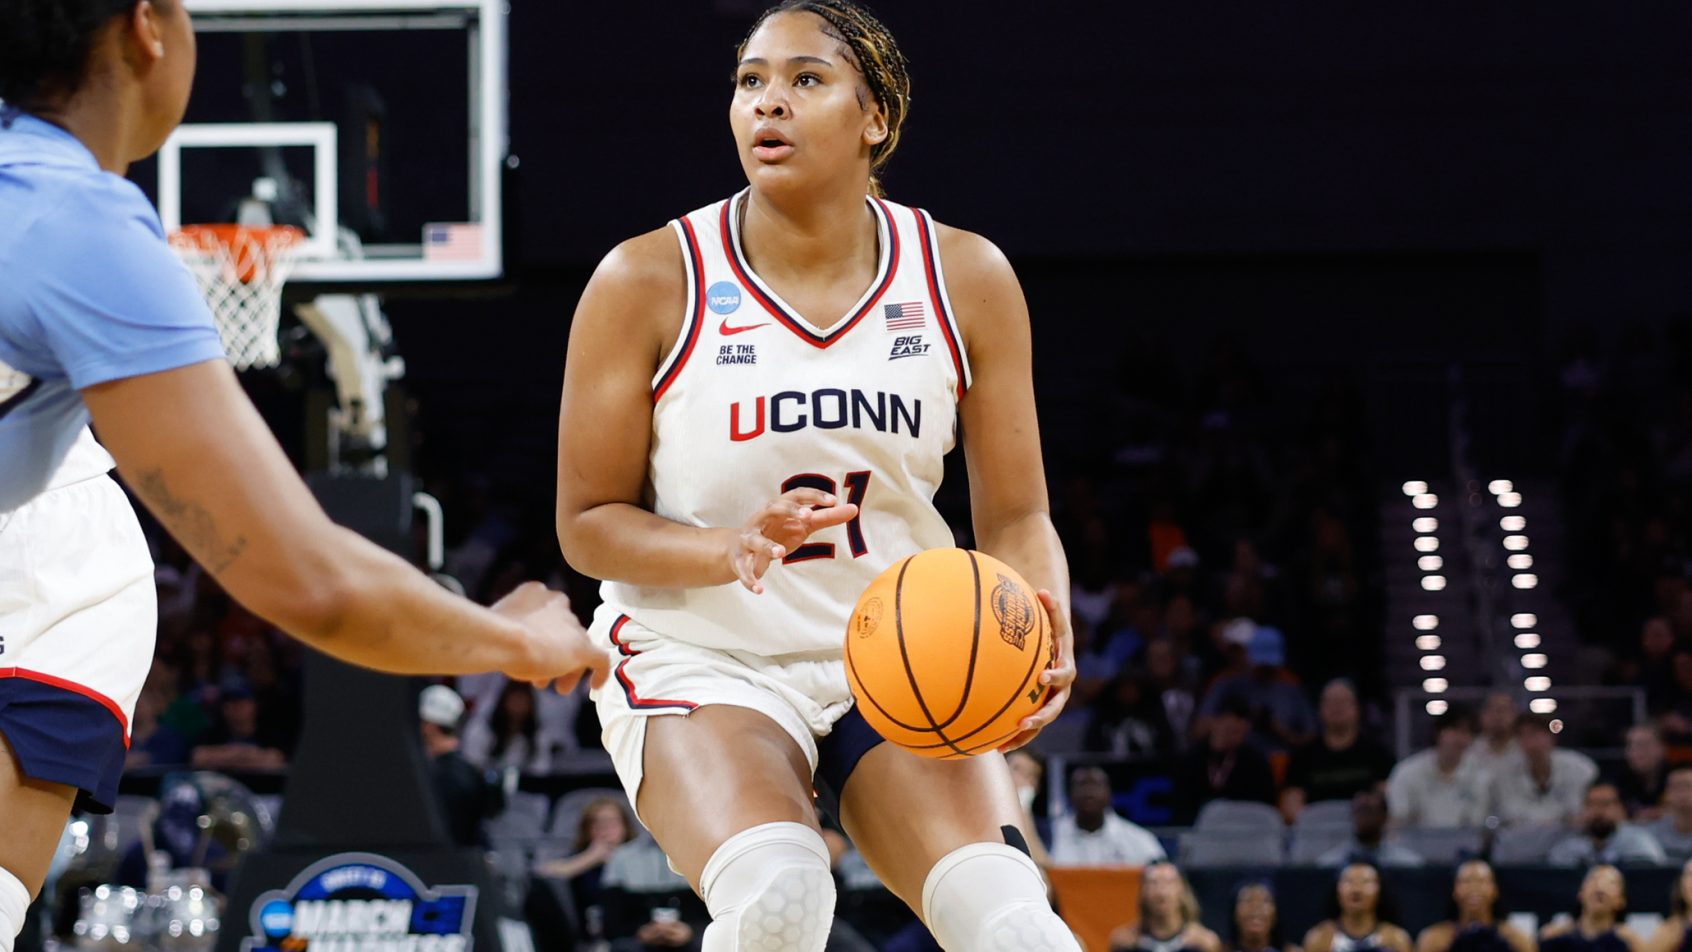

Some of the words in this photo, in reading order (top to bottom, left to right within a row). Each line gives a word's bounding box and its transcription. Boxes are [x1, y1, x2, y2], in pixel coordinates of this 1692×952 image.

[711, 295, 739, 306] NCAA
[894, 335, 922, 346] BIG
[719, 345, 733, 355] BE
[736, 344, 755, 355] THE
[890, 344, 931, 356] EAST
[716, 354, 757, 366] CHANGE
[730, 388, 922, 442] UCONN
[294, 899, 413, 934] MARCH
